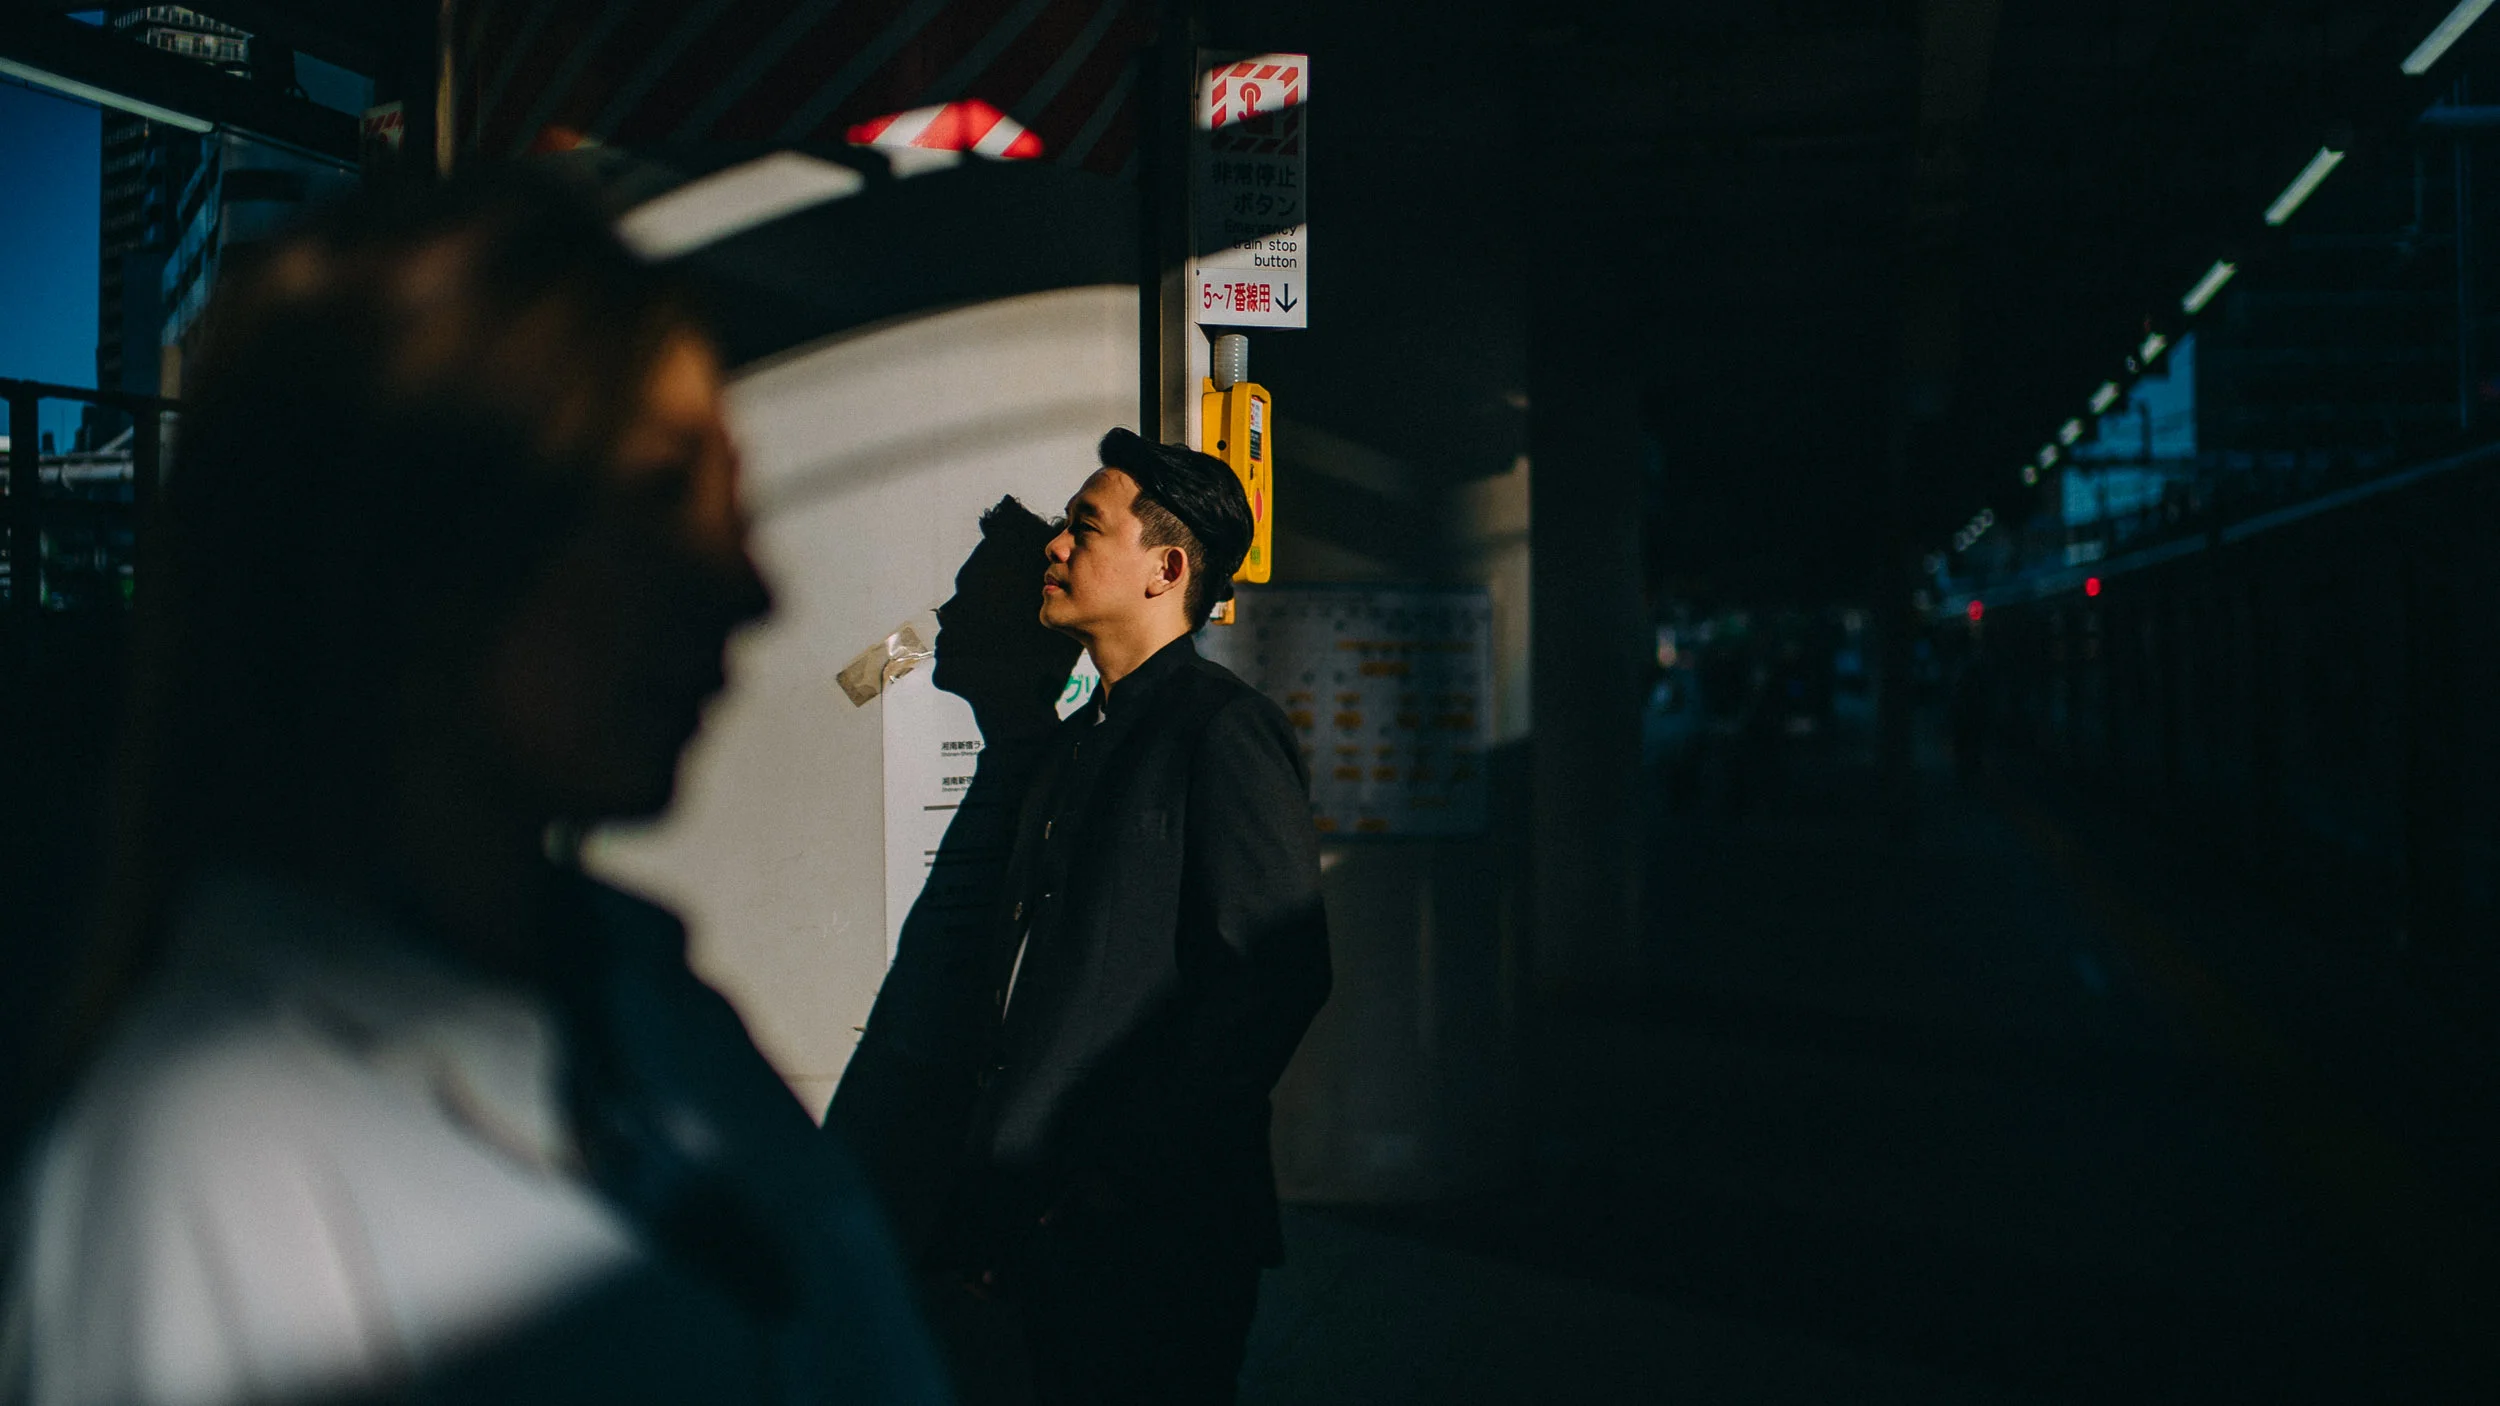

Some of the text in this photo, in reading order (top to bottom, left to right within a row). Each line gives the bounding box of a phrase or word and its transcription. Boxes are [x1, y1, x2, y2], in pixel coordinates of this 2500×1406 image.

[1233, 192, 1296, 216] ボタン
[1233, 235, 1298, 253] train stop
[1254, 253, 1297, 268] button
